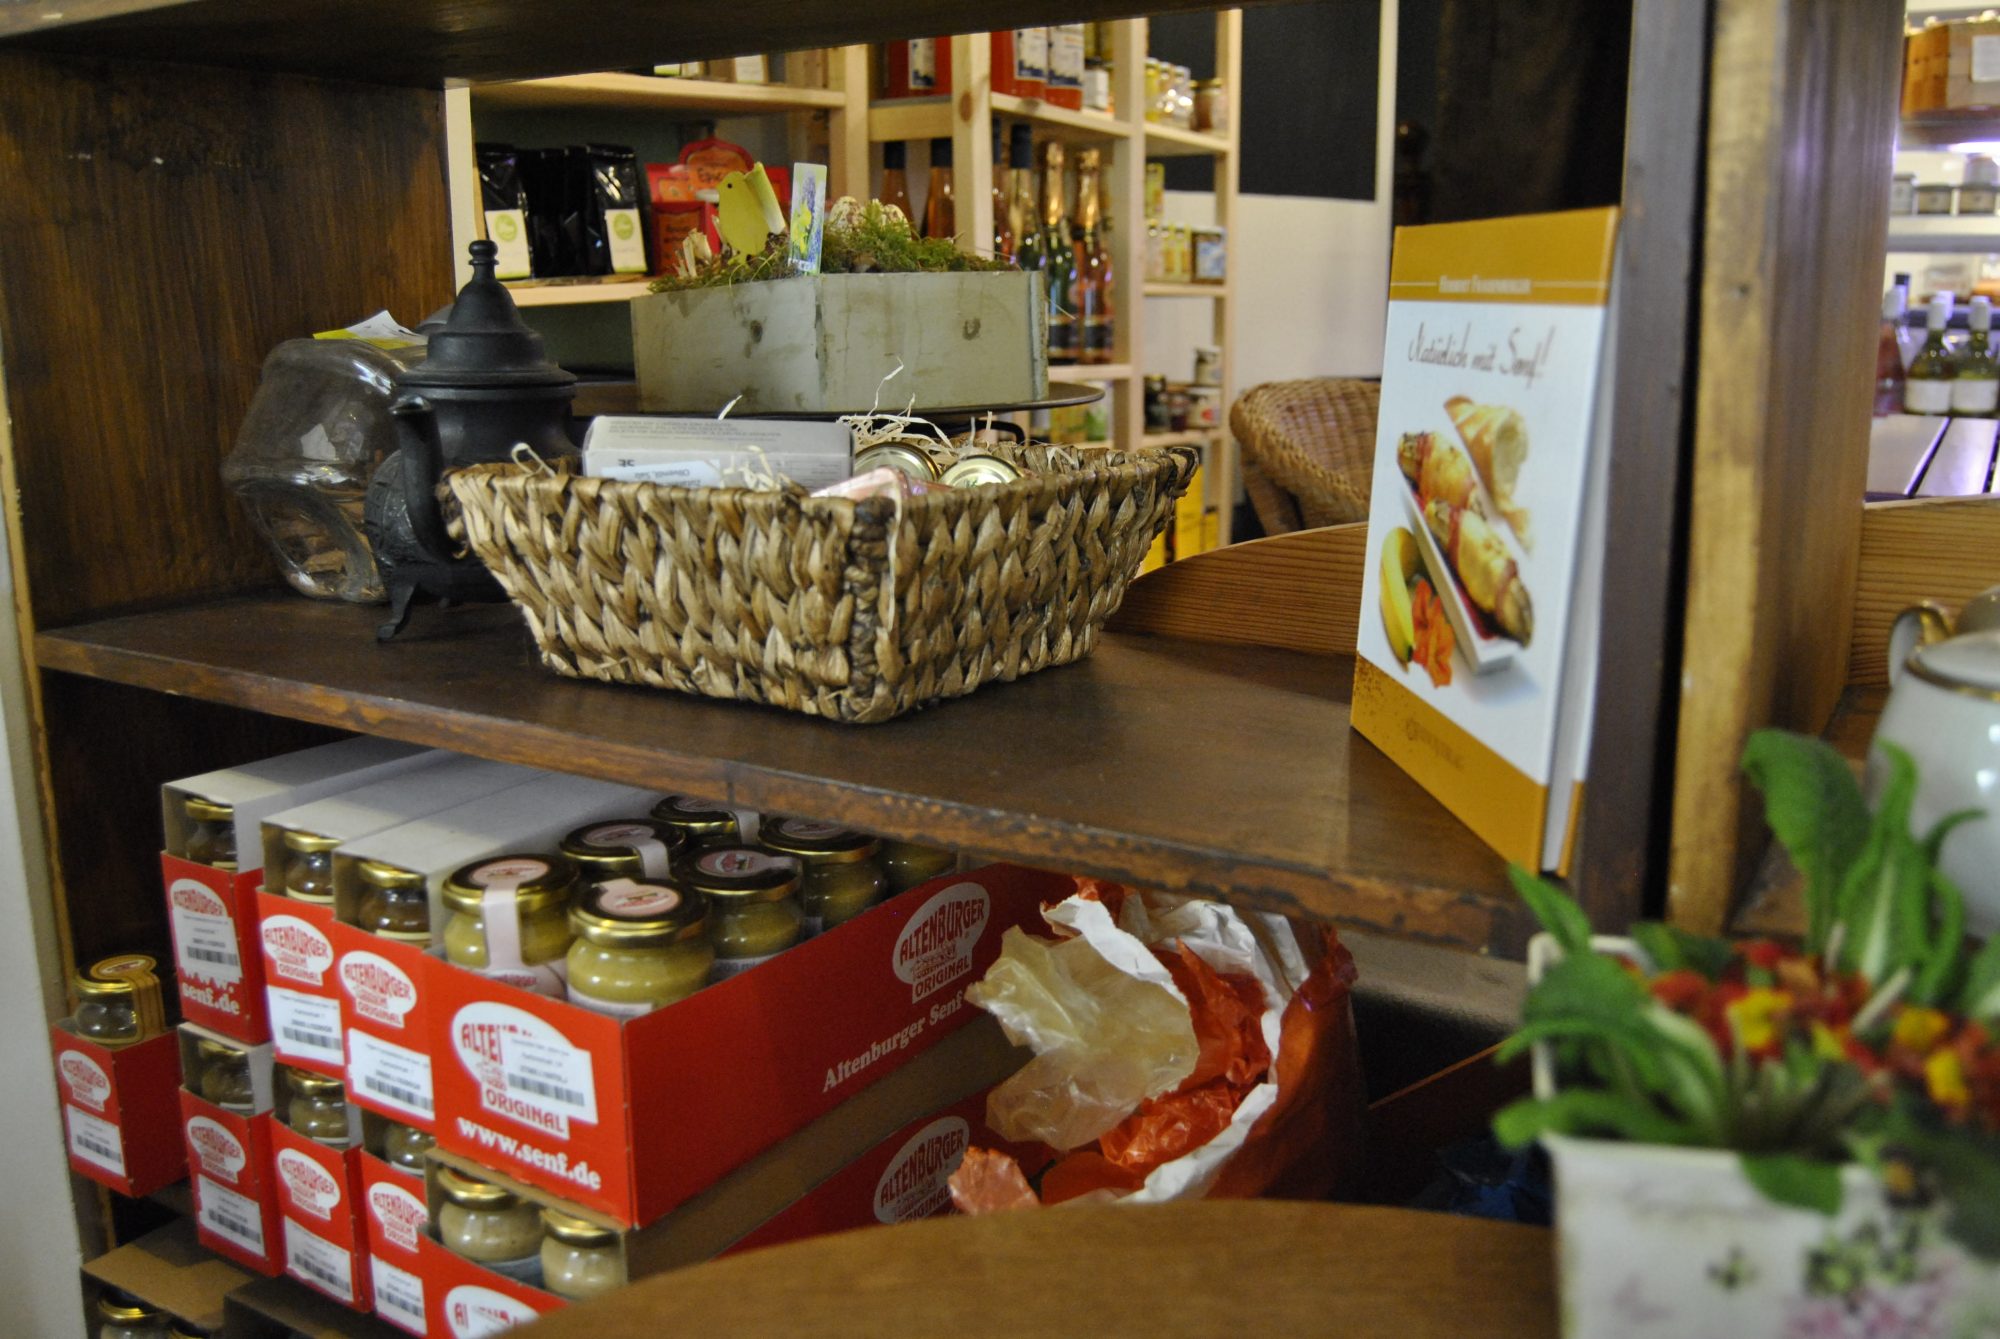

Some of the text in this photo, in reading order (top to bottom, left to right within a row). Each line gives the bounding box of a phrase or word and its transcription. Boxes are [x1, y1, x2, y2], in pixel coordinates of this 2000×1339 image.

[263, 925, 329, 959] ALTENBURGER
[900, 898, 985, 967] ALTENBURGER
[279, 962, 321, 983] ORIGINAL
[344, 963, 412, 1000] ALTENBURGER
[914, 954, 970, 998] ORIGINAL
[357, 1000, 403, 1026] ORIGINAL
[823, 989, 965, 1094] Altenburger Senf
[486, 1089, 565, 1133] ORIGINAL
[457, 1116, 602, 1190] www.senf.de
[880, 1128, 965, 1208] ALTENBURGER
